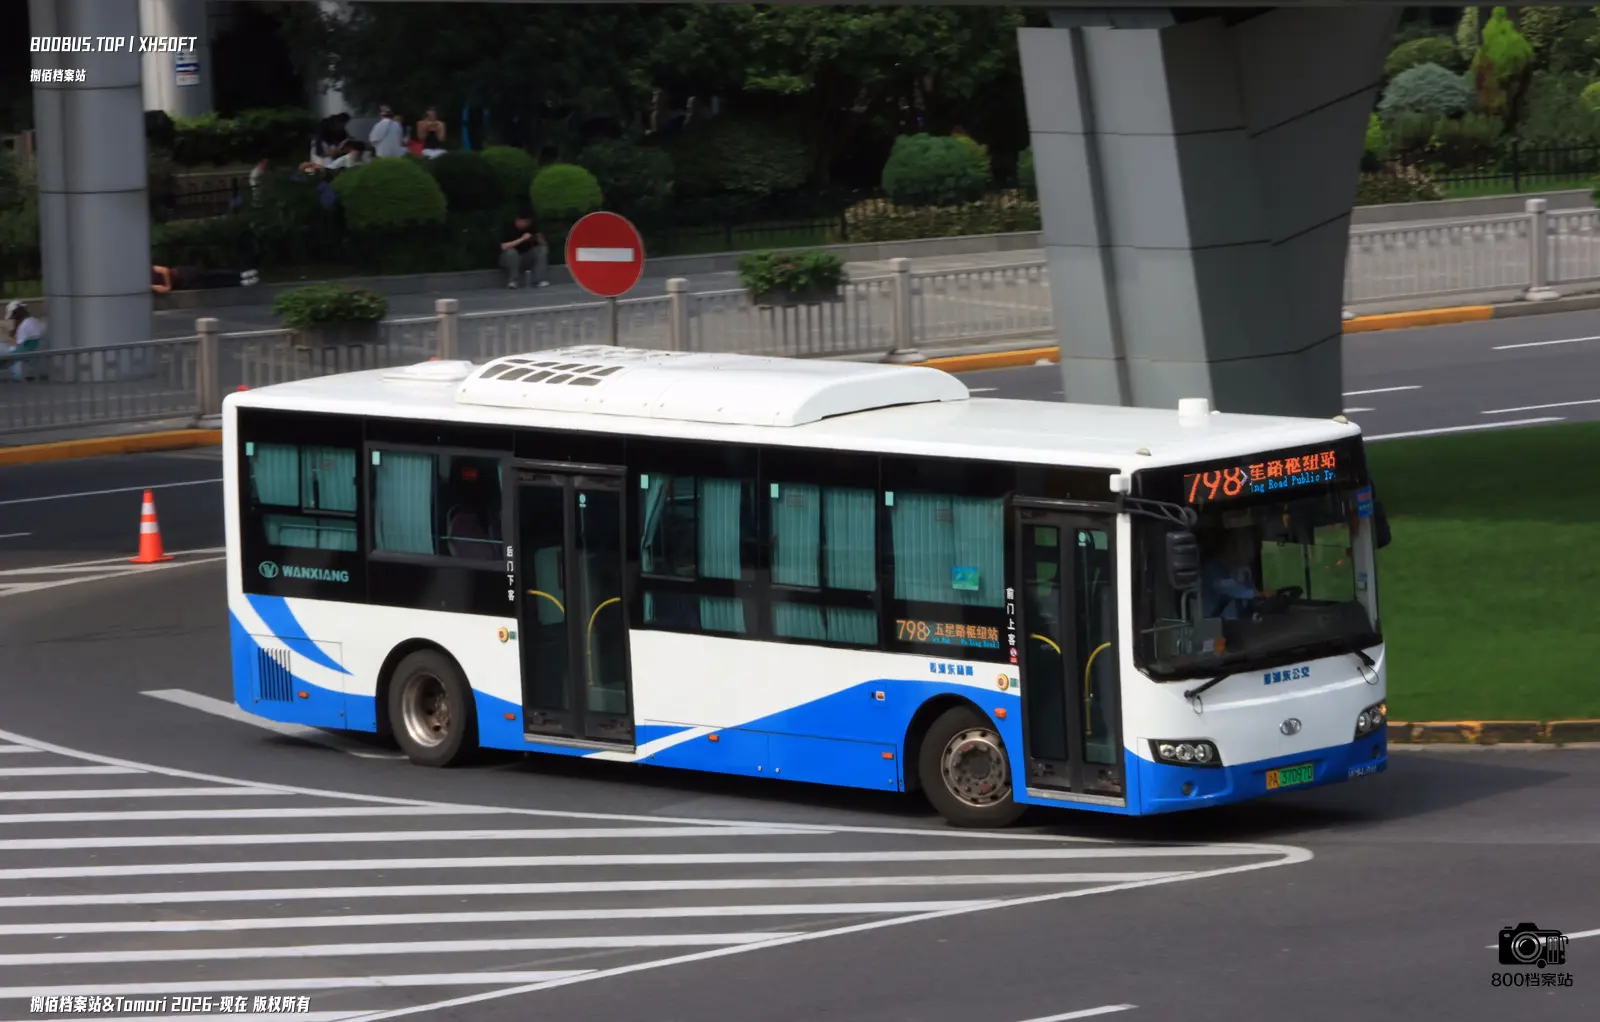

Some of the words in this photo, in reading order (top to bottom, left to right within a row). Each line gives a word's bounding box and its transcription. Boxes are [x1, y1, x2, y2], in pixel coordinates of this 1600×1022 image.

[1183, 466, 1242, 503] 798
[1268, 475, 1288, 489] Road
[1291, 471, 1320, 486] Public
[281, 564, 350, 583] WANXIANG
[506, 545, 515, 601] 后门下客
[896, 619, 927, 641] 798
[934, 622, 999, 641] 五星路枢纽站
[1006, 587, 1016, 646] 前门上客
